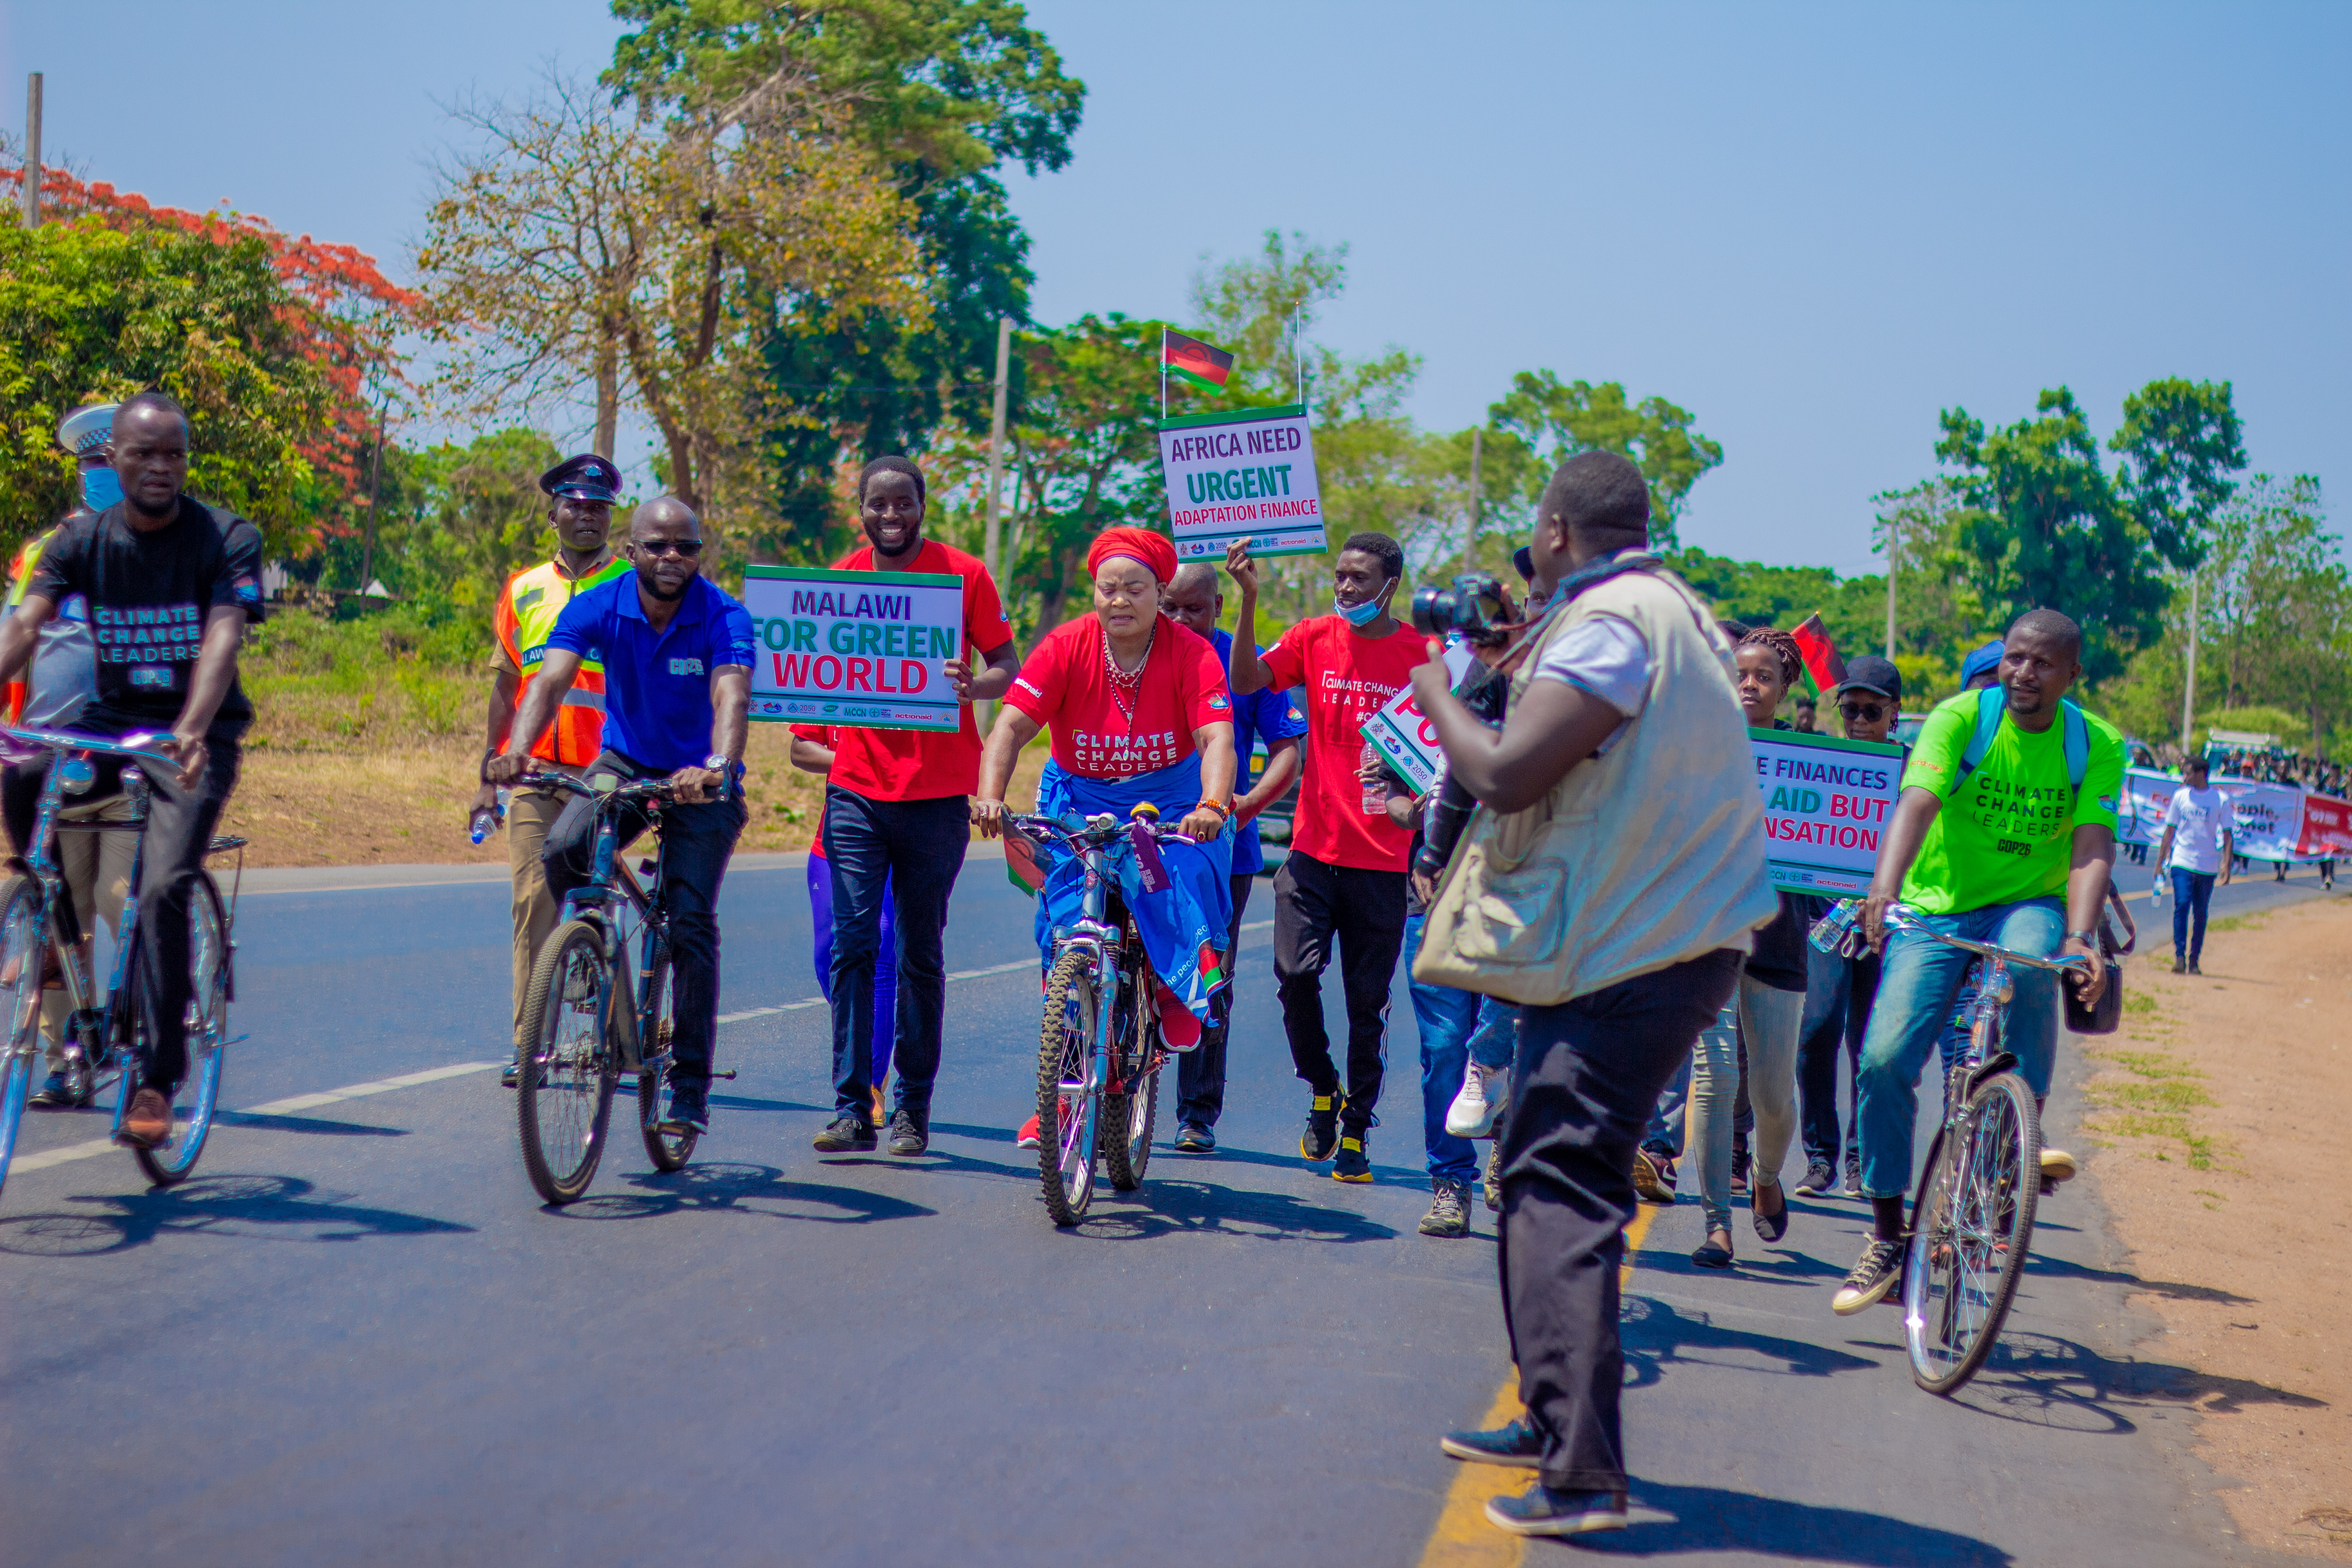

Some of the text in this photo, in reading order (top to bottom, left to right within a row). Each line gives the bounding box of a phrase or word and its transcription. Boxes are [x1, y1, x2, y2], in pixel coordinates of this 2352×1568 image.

[1171, 427, 1301, 462] AFRICA NEED
[1186, 464, 1291, 504] URGENT
[1175, 499, 1318, 526] ADAPTATION FINANCE
[98, 607, 197, 625] CLIMATE
[792, 591, 911, 621] MALAWI
[98, 626, 199, 643] CHANGE
[752, 617, 955, 659] FOR GREEN
[100, 645, 201, 662] LEADERS
[133, 670, 170, 685] COP26
[772, 652, 928, 694] WORLD
[1326, 678, 1402, 697] CLIMATE CHANG
[844, 708, 867, 717] MCCN
[1076, 731, 1175, 748] CLIMATE
[1075, 747, 1176, 761] CHANGE
[1412, 764, 1427, 780] 2050
[1775, 759, 1888, 790] FINANCES
[1980, 777, 2065, 801] CLIMATE
[1769, 786, 1891, 823] AID BUT
[1976, 795, 2064, 818] CHANGE
[1973, 811, 2059, 836] LEADERS
[1997, 839, 2031, 856] COP26
[1177, 948, 1198, 978] people
